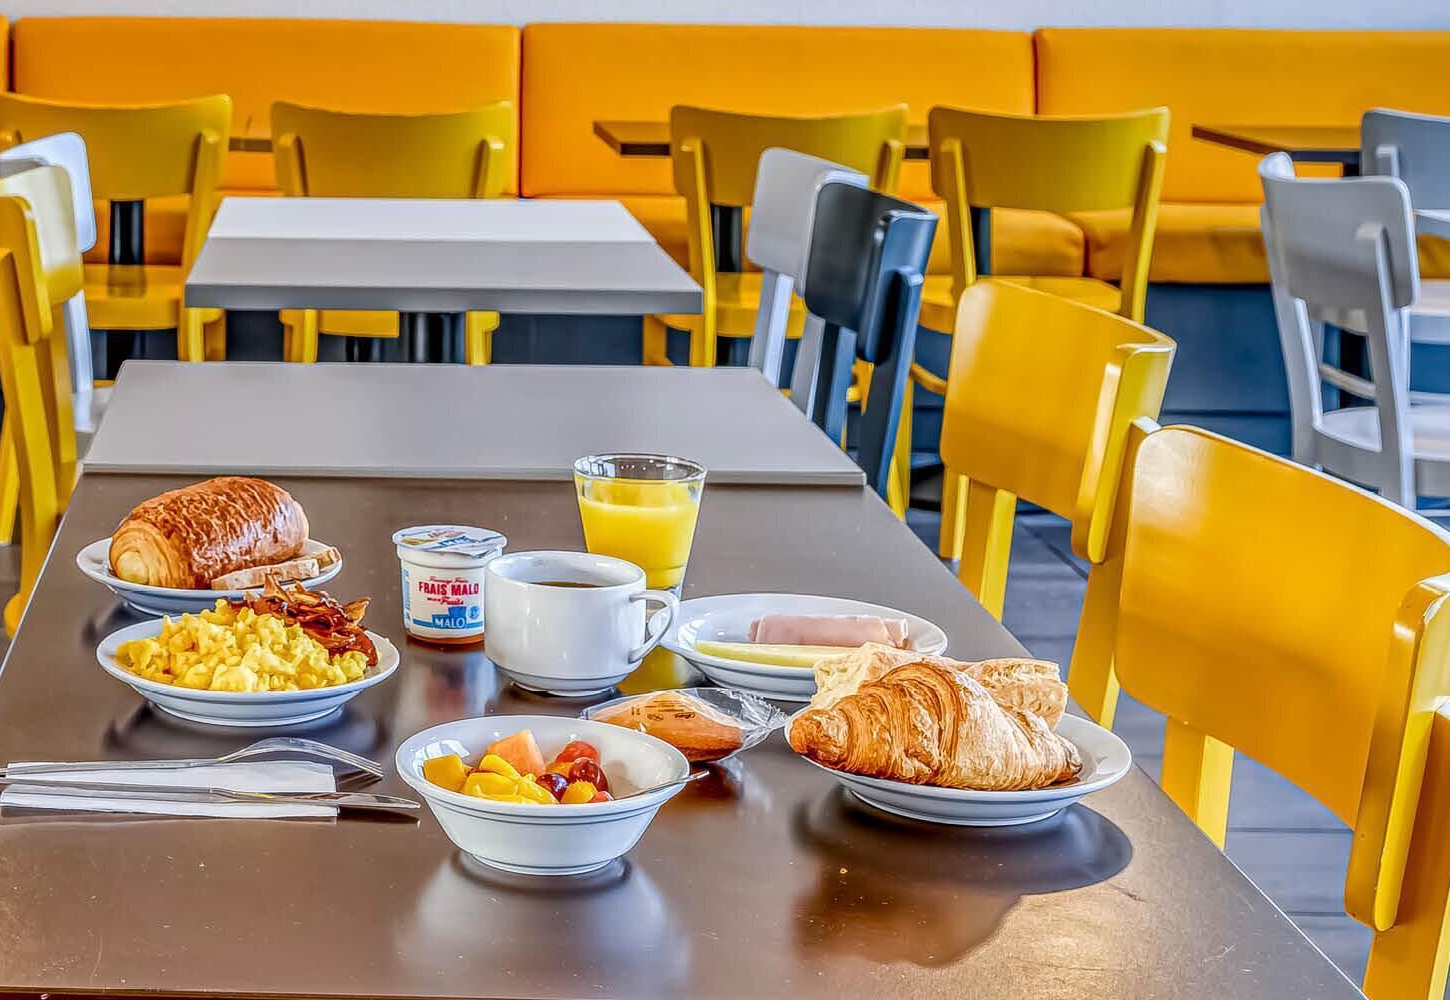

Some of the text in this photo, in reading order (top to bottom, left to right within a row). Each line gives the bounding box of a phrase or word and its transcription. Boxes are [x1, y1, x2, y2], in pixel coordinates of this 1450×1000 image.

[418, 581, 480, 596] FRAIS MALO
[434, 617, 465, 628] MALO
